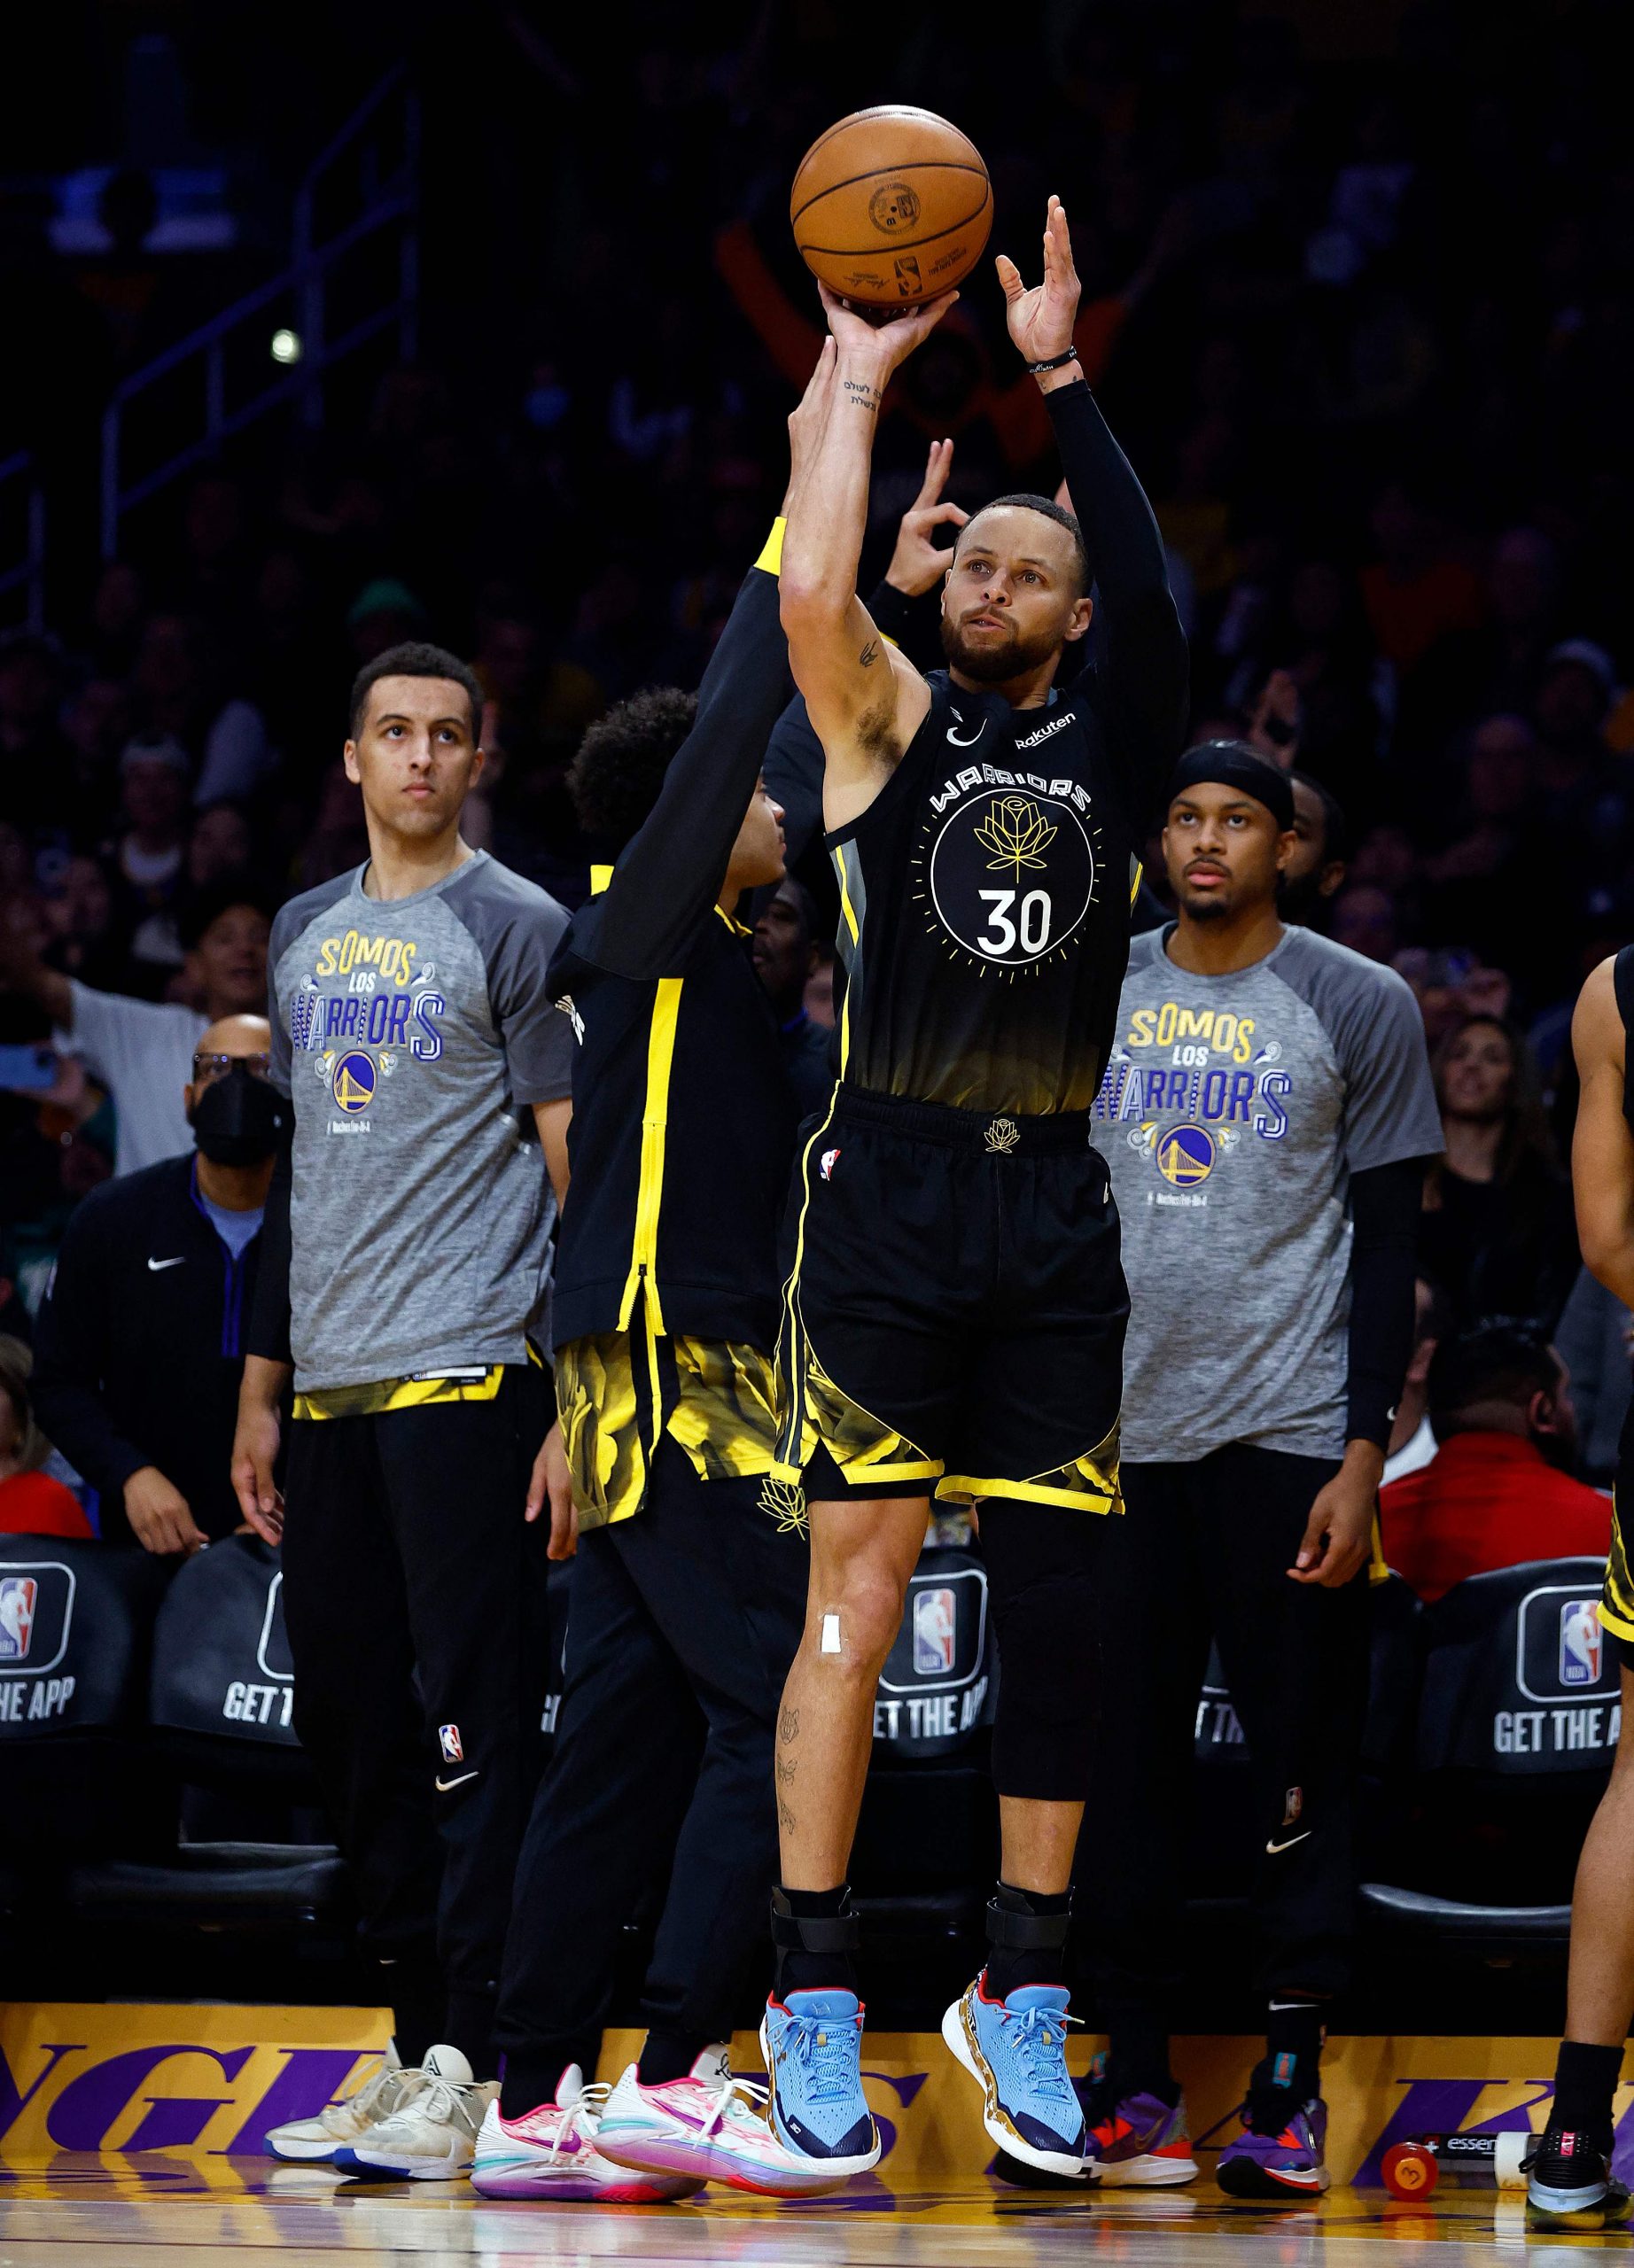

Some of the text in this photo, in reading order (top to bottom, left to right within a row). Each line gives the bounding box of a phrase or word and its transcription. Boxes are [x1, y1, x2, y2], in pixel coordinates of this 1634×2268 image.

[1015, 712, 1077, 750] Rakuten
[930, 763, 1092, 812] WARRIORS
[977, 889, 1052, 956] 30
[316, 929, 416, 987] SOMOS
[348, 971, 377, 993] LOS
[292, 989, 446, 1061] WARRIORS
[1127, 1002, 1256, 1064] SOMOS
[1172, 1045, 1210, 1068] LOS
[1095, 1063, 1292, 1141] WARRIORS
[0, 1676, 76, 1722] HE APP
[223, 1681, 279, 1725] GET
[873, 1699, 903, 1739] ET
[906, 1695, 958, 1738] THE
[1494, 1711, 1548, 1753] GET
[1551, 1707, 1605, 1751] THE
[1447, 2137, 1497, 2151] essen
